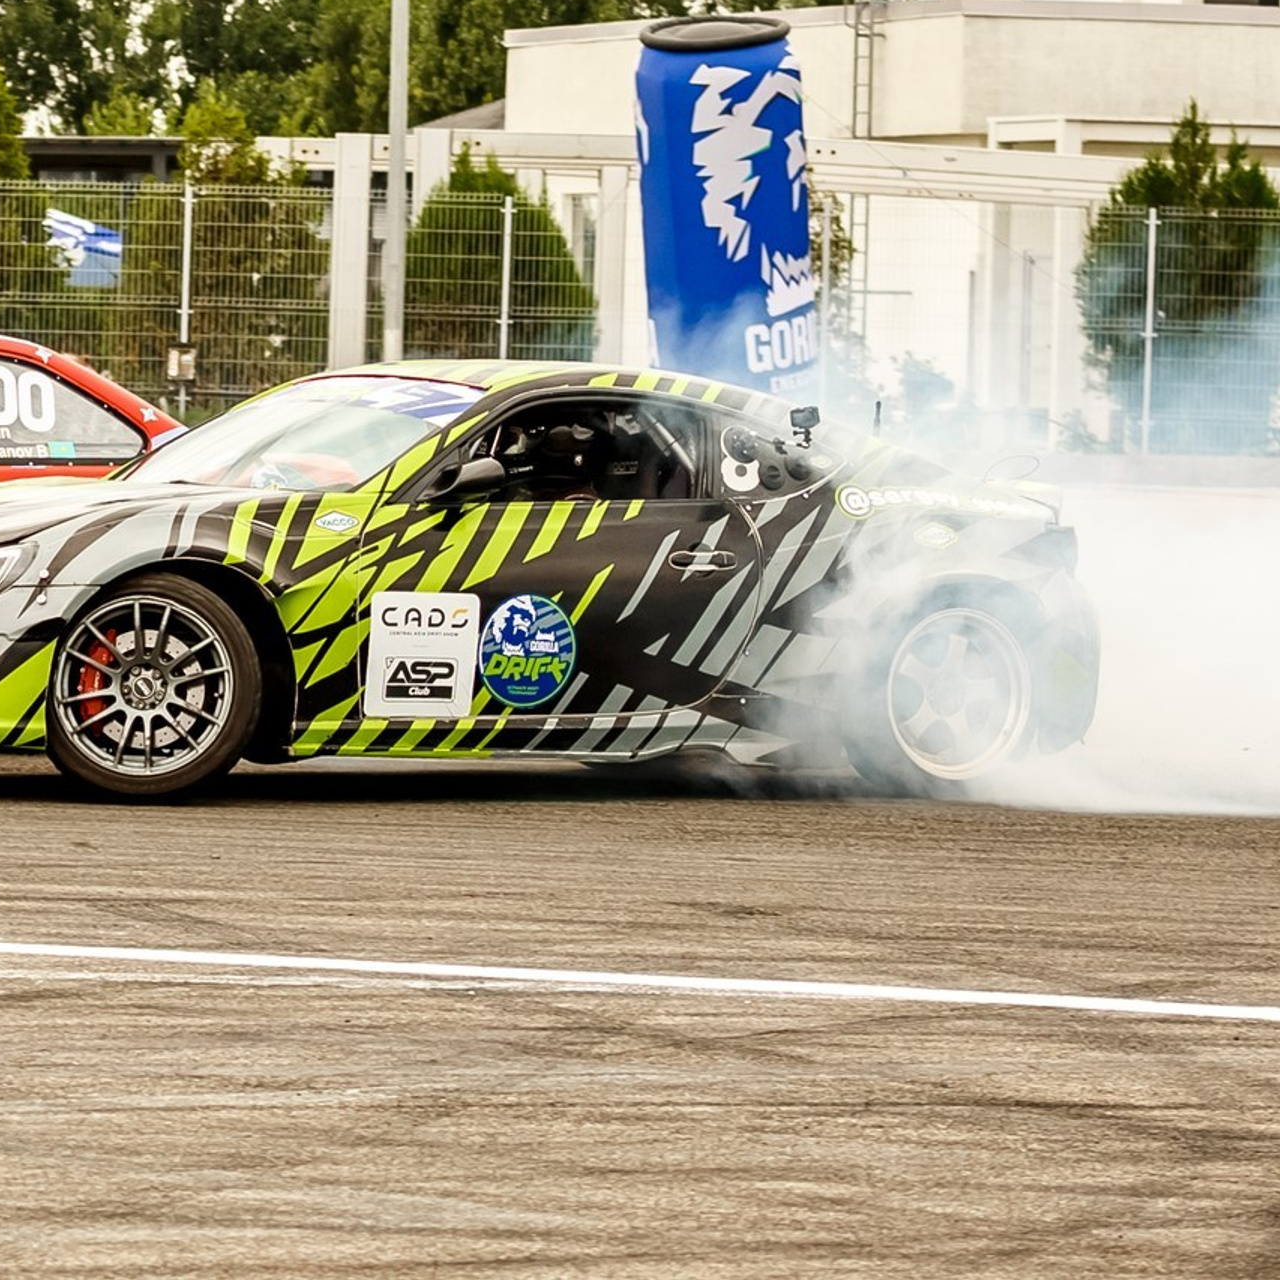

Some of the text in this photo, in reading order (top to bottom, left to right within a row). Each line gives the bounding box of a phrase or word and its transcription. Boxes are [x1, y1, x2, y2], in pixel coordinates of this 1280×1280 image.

[381, 607, 468, 628] CADS
[387, 661, 454, 684] ASP
[408, 686, 430, 696] Club
